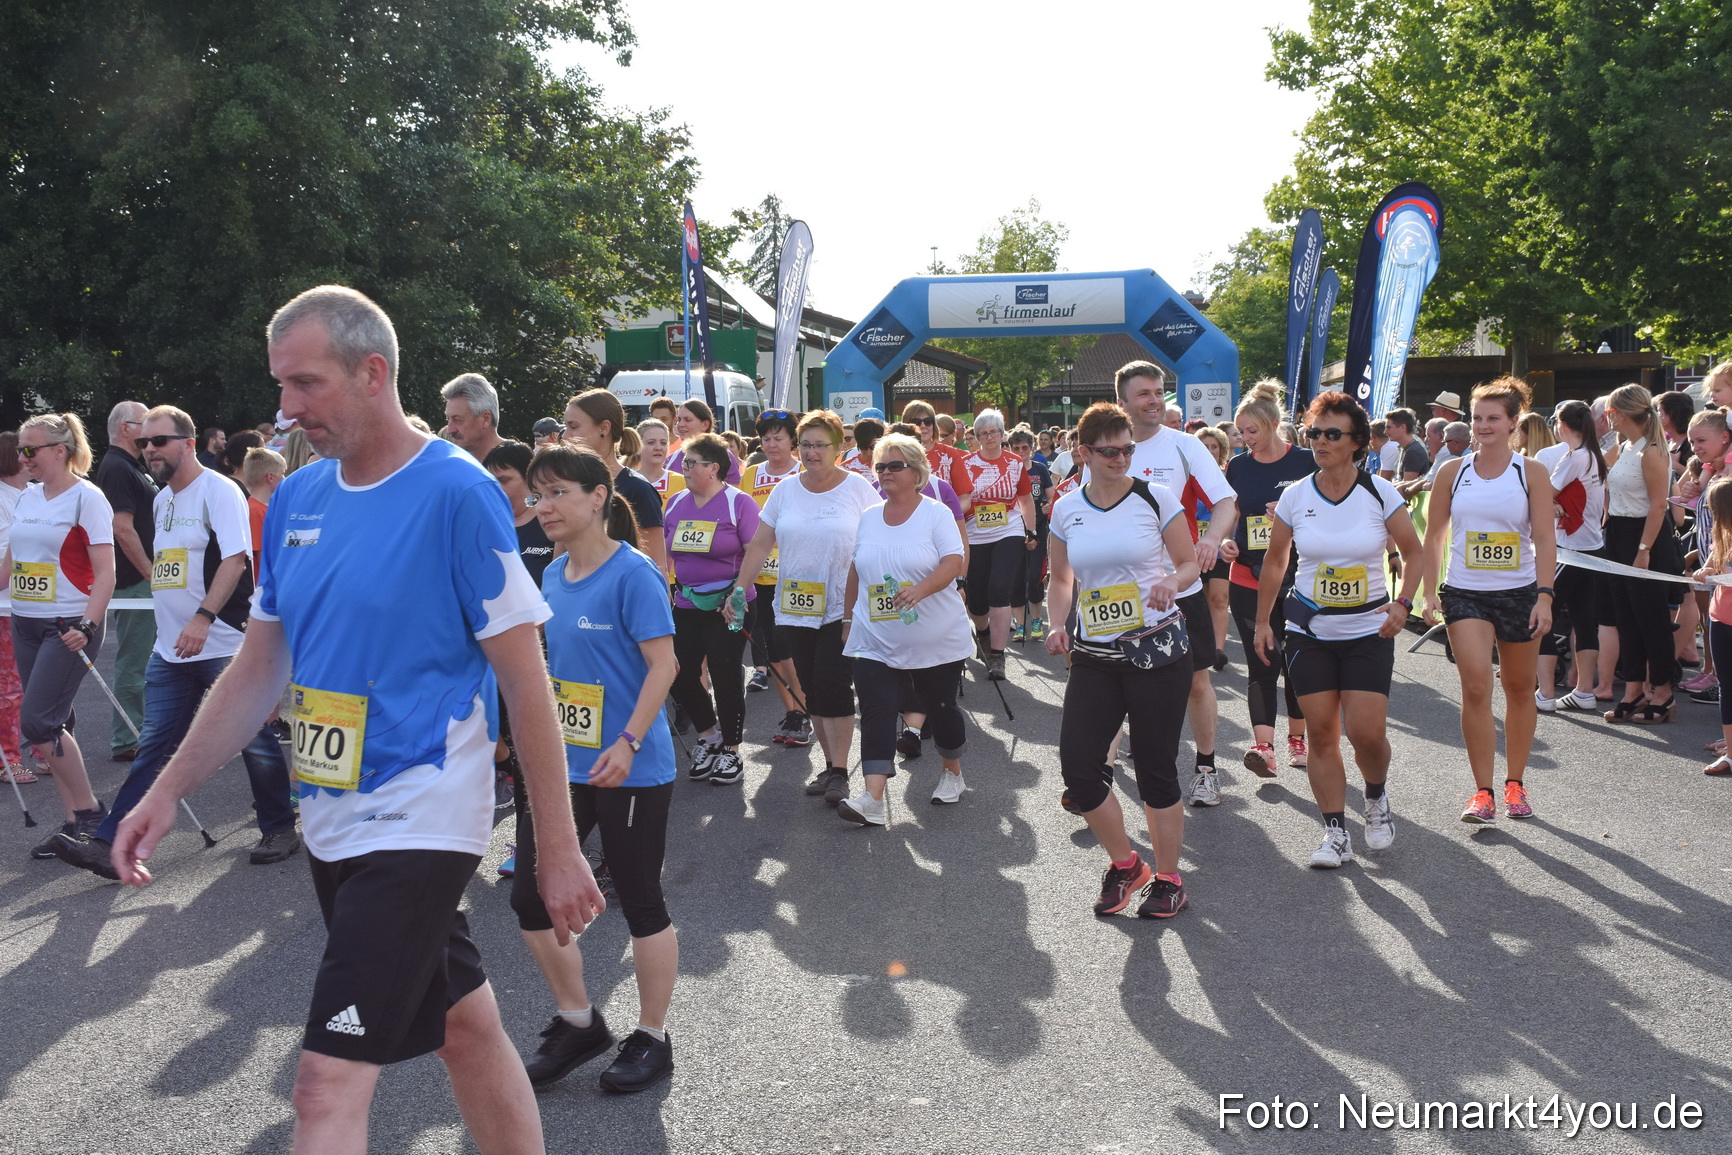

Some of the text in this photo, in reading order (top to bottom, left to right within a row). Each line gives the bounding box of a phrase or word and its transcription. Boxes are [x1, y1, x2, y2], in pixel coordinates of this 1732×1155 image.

[1297, 227, 1314, 298] Fischer
[1022, 290, 1047, 299] Fischer
[1003, 303, 1077, 319] firmenlauf
[866, 333, 906, 342] Fischer
[979, 511, 1004, 523] 2234
[681, 530, 705, 543] 642
[1472, 545, 1513, 560] 1889
[153, 562, 181, 578] 1096
[13, 575, 48, 592] 1095
[1320, 579, 1360, 597] 1891
[789, 592, 815, 608] 365
[1088, 600, 1133, 623] 1890
[309, 757, 340, 772] Markus
[326, 1020, 366, 1036] adidas
